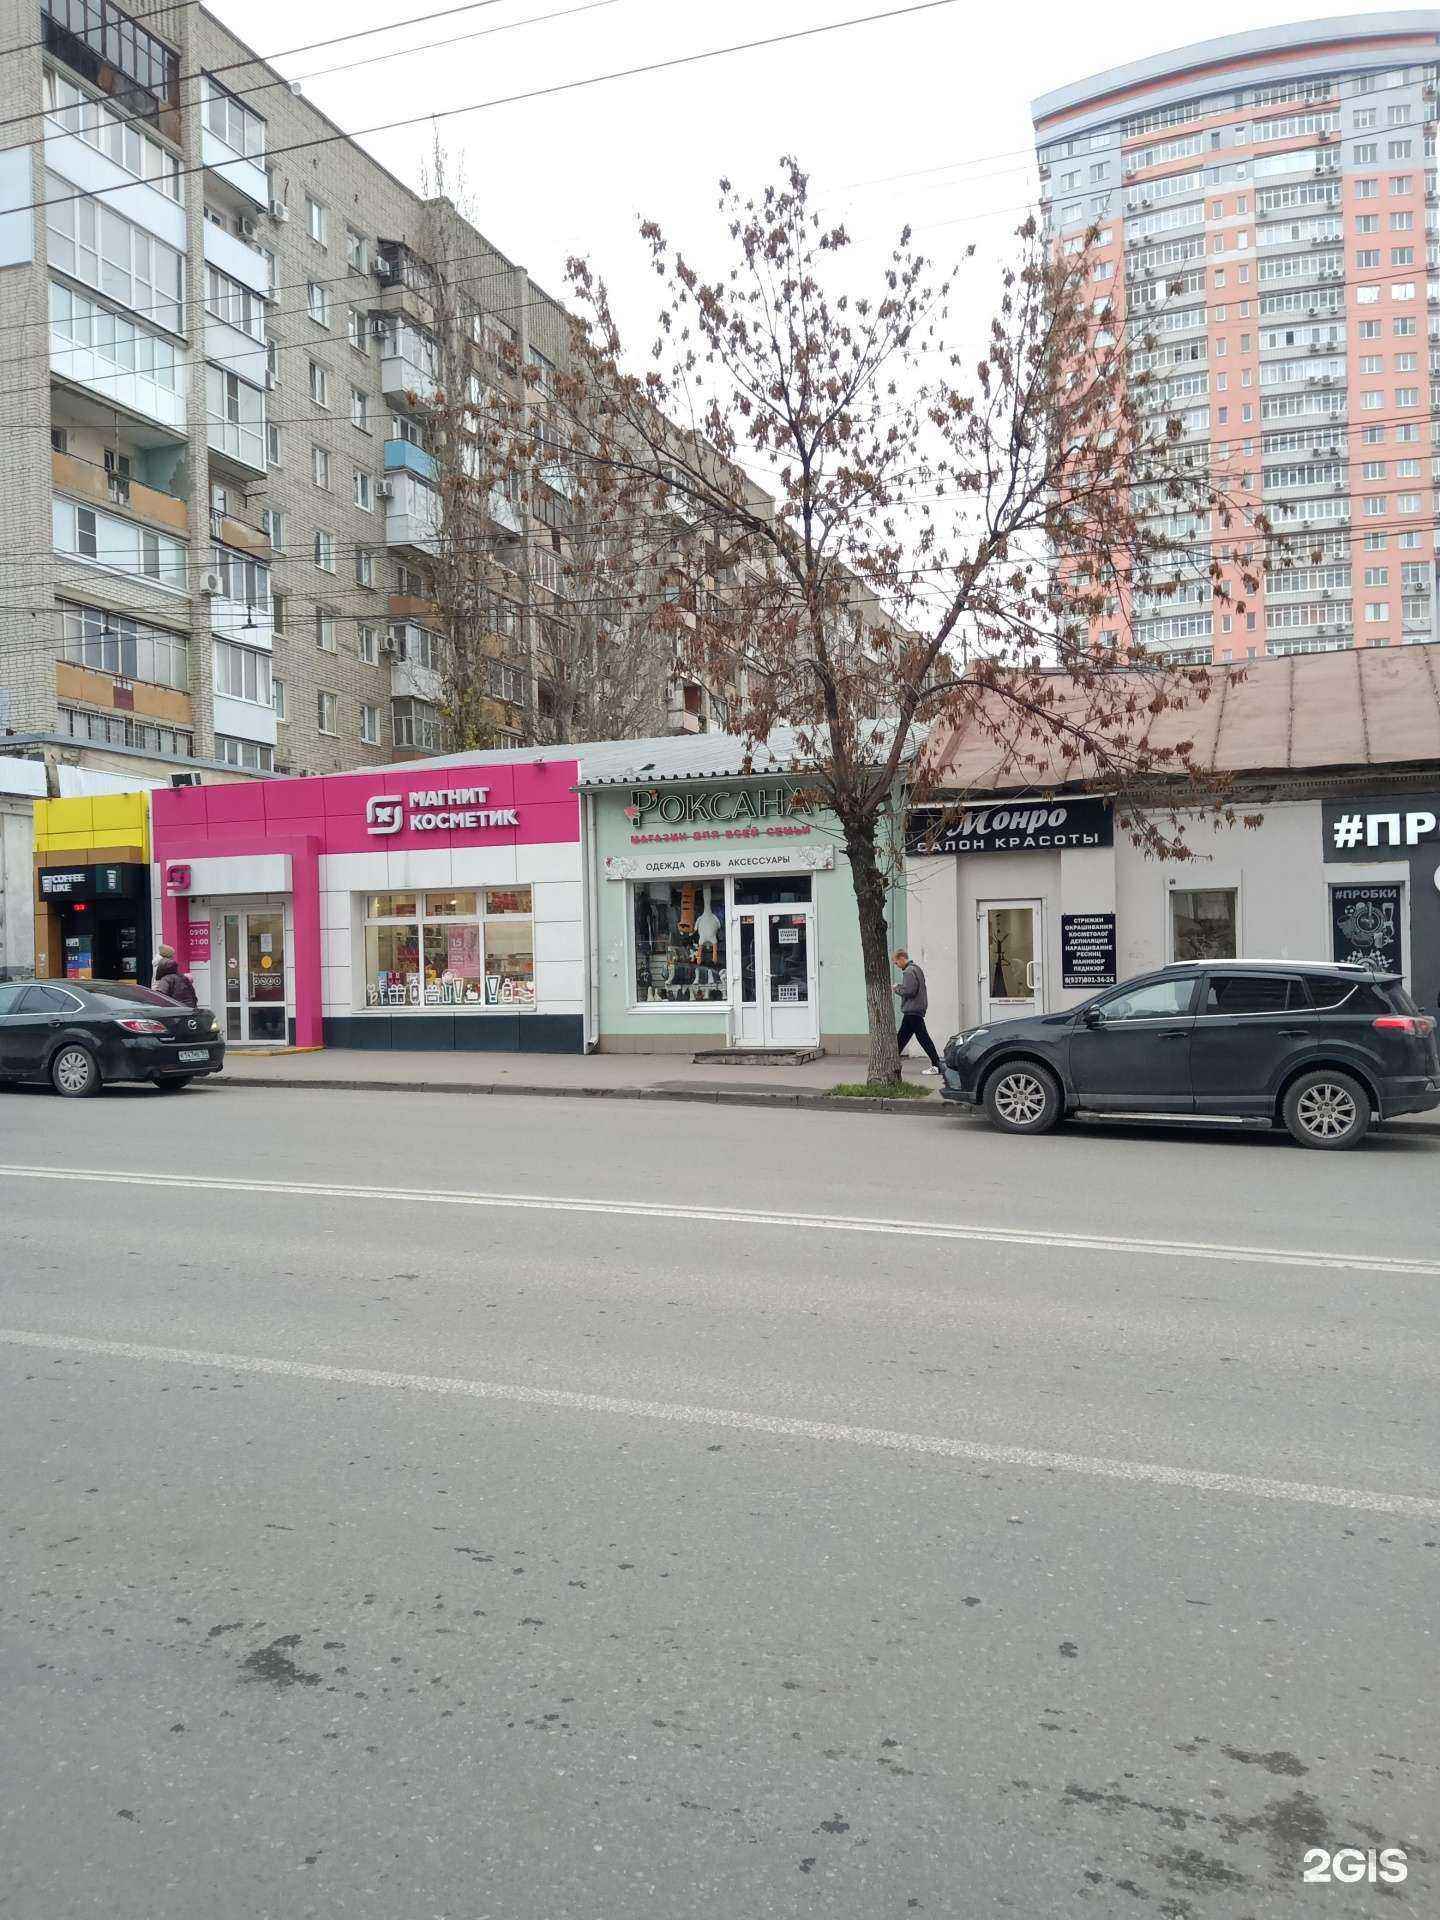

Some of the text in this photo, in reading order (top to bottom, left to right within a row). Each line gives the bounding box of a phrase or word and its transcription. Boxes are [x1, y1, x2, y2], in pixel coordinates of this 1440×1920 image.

[408, 787, 490, 808] МАГНИТ
[630, 789, 812, 828] РОКСАНА
[410, 808, 520, 831] КОСМЕТИК
[946, 808, 1068, 836] Монро
[1333, 811, 1440, 848] #ПР
[917, 832, 1100, 852] САЛОН КРАСОТЫ
[645, 855, 791, 872] ОДЕЖДА ОБУВЬ АКСЕССУАРЫ
[52, 873, 86, 883] COFFEE
[52, 883, 73, 892] LIKE
[1335, 888, 1397, 900] #ПРОБКИ
